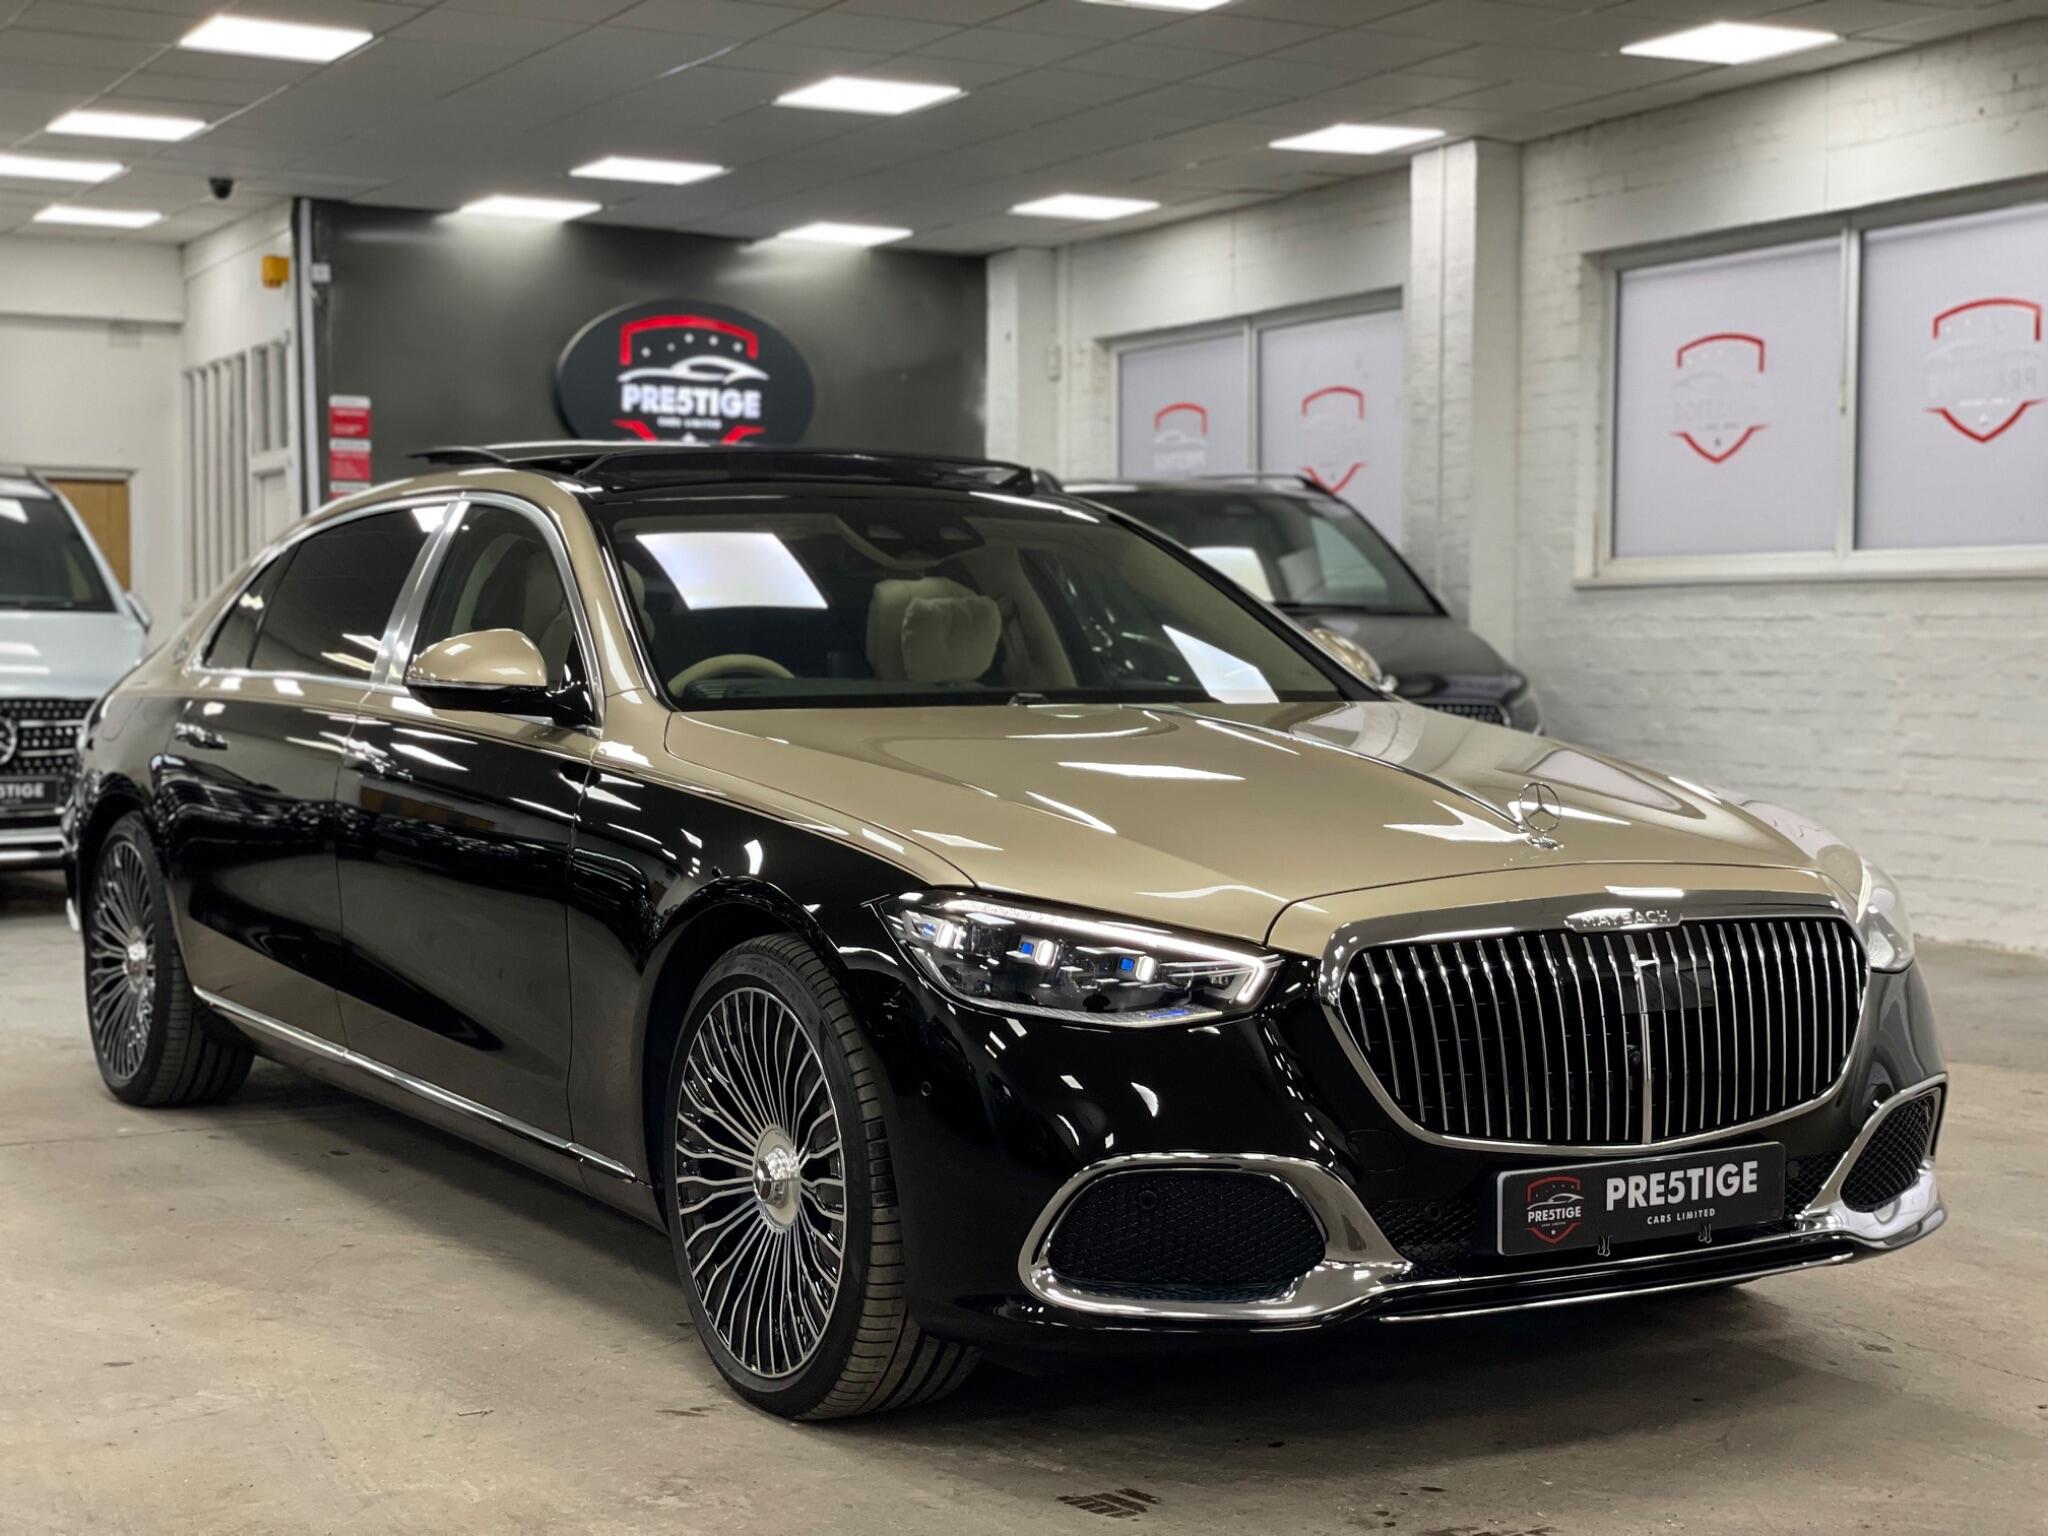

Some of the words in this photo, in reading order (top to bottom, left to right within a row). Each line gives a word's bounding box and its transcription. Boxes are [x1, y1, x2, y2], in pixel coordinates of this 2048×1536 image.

[1580, 909, 1671, 928] MAYBACH
[1606, 1160, 1759, 1211] PRE5TIGE
[1527, 1205, 1582, 1223] PRE5TIGE
[1646, 1213, 1672, 1225] CARS
[1676, 1207, 1716, 1221] LIMITED
